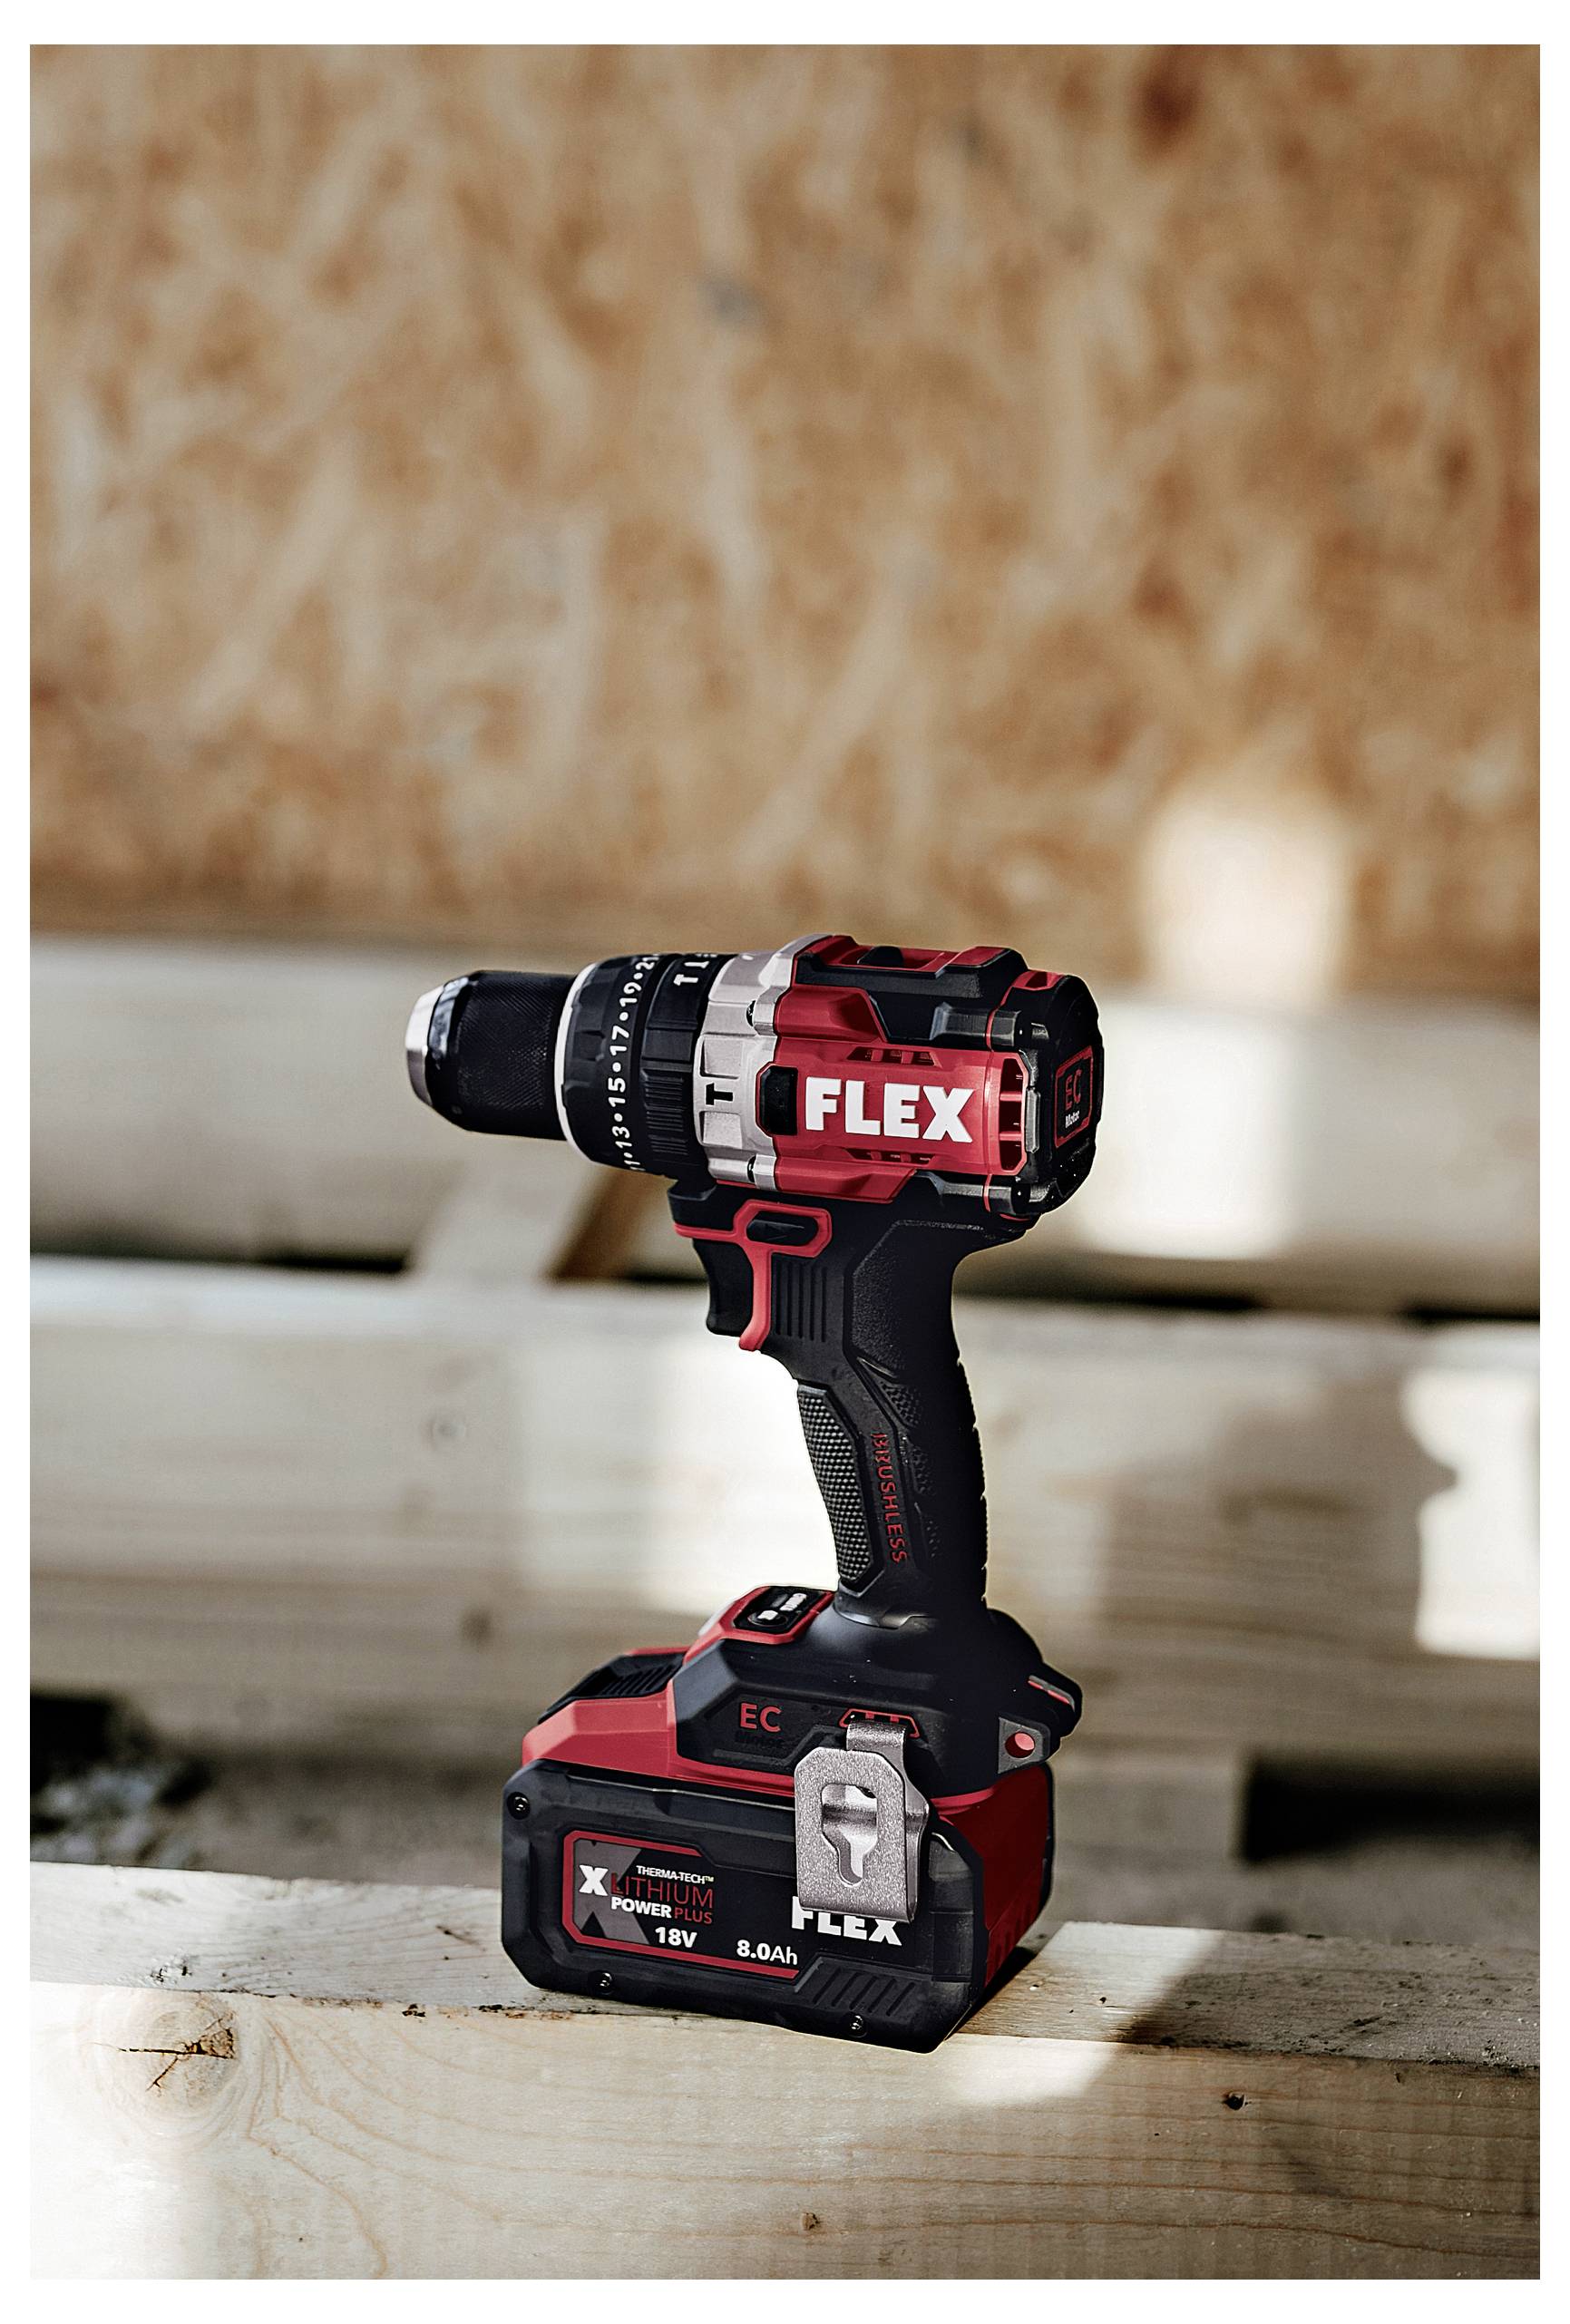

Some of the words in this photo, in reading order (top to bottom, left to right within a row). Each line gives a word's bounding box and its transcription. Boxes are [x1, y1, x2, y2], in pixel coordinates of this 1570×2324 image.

[1065, 1069, 1083, 1111] EC
[805, 1076, 974, 1143] FLEX
[871, 1432, 907, 1564] BRUSHLESS
[739, 1702, 783, 1734] EC
[610, 1872, 714, 1909] LITHIUM
[610, 1896, 672, 1919] POWER
[674, 1907, 713, 1924] PLUS
[655, 1926, 697, 1949] 18V
[736, 1939, 798, 1966] 8.0Ah
